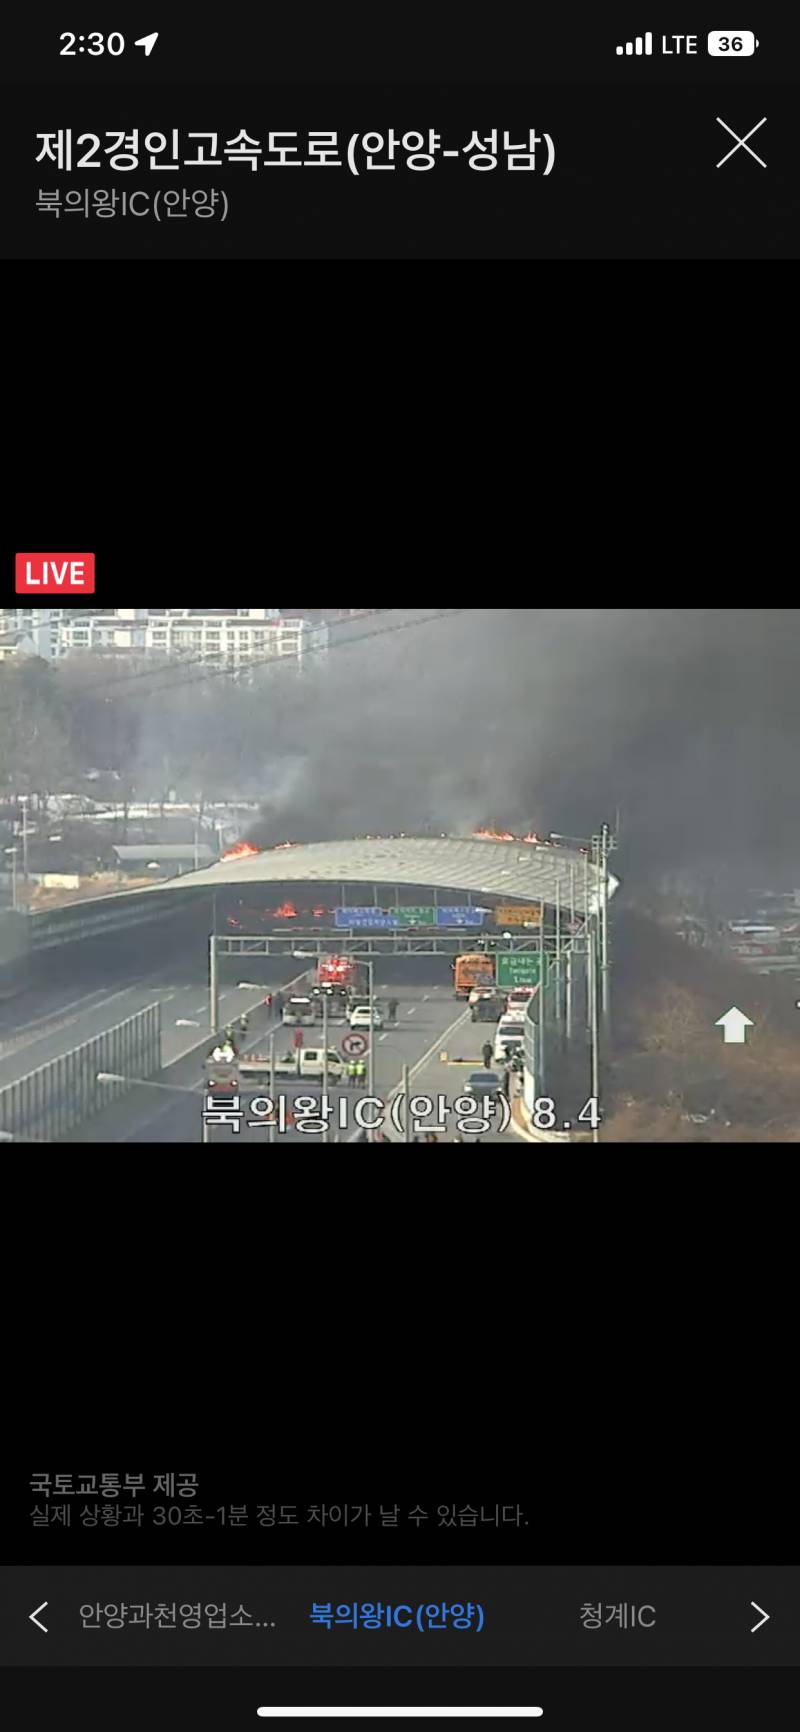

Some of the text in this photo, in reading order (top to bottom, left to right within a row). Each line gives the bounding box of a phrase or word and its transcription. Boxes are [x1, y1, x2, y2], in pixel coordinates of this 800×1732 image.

[57, 32, 125, 56] 2:30
[661, 34, 698, 55] LTE
[717, 36, 744, 53] 36
[35, 127, 556, 176] 제2경인고속도로(안양-성남)
[35, 187, 229, 222] 북의왕IC(안양)
[25, 560, 85, 586] LIVE
[29, 1472, 200, 1499] 국토교통부 제공
[29, 1503, 529, 1528] 실제 상황과 30초-1분 정도 차이가 날 수 있습니다.
[309, 1601, 485, 1633] 북의왕IC(안양)
[579, 1601, 657, 1630] 청계IC
